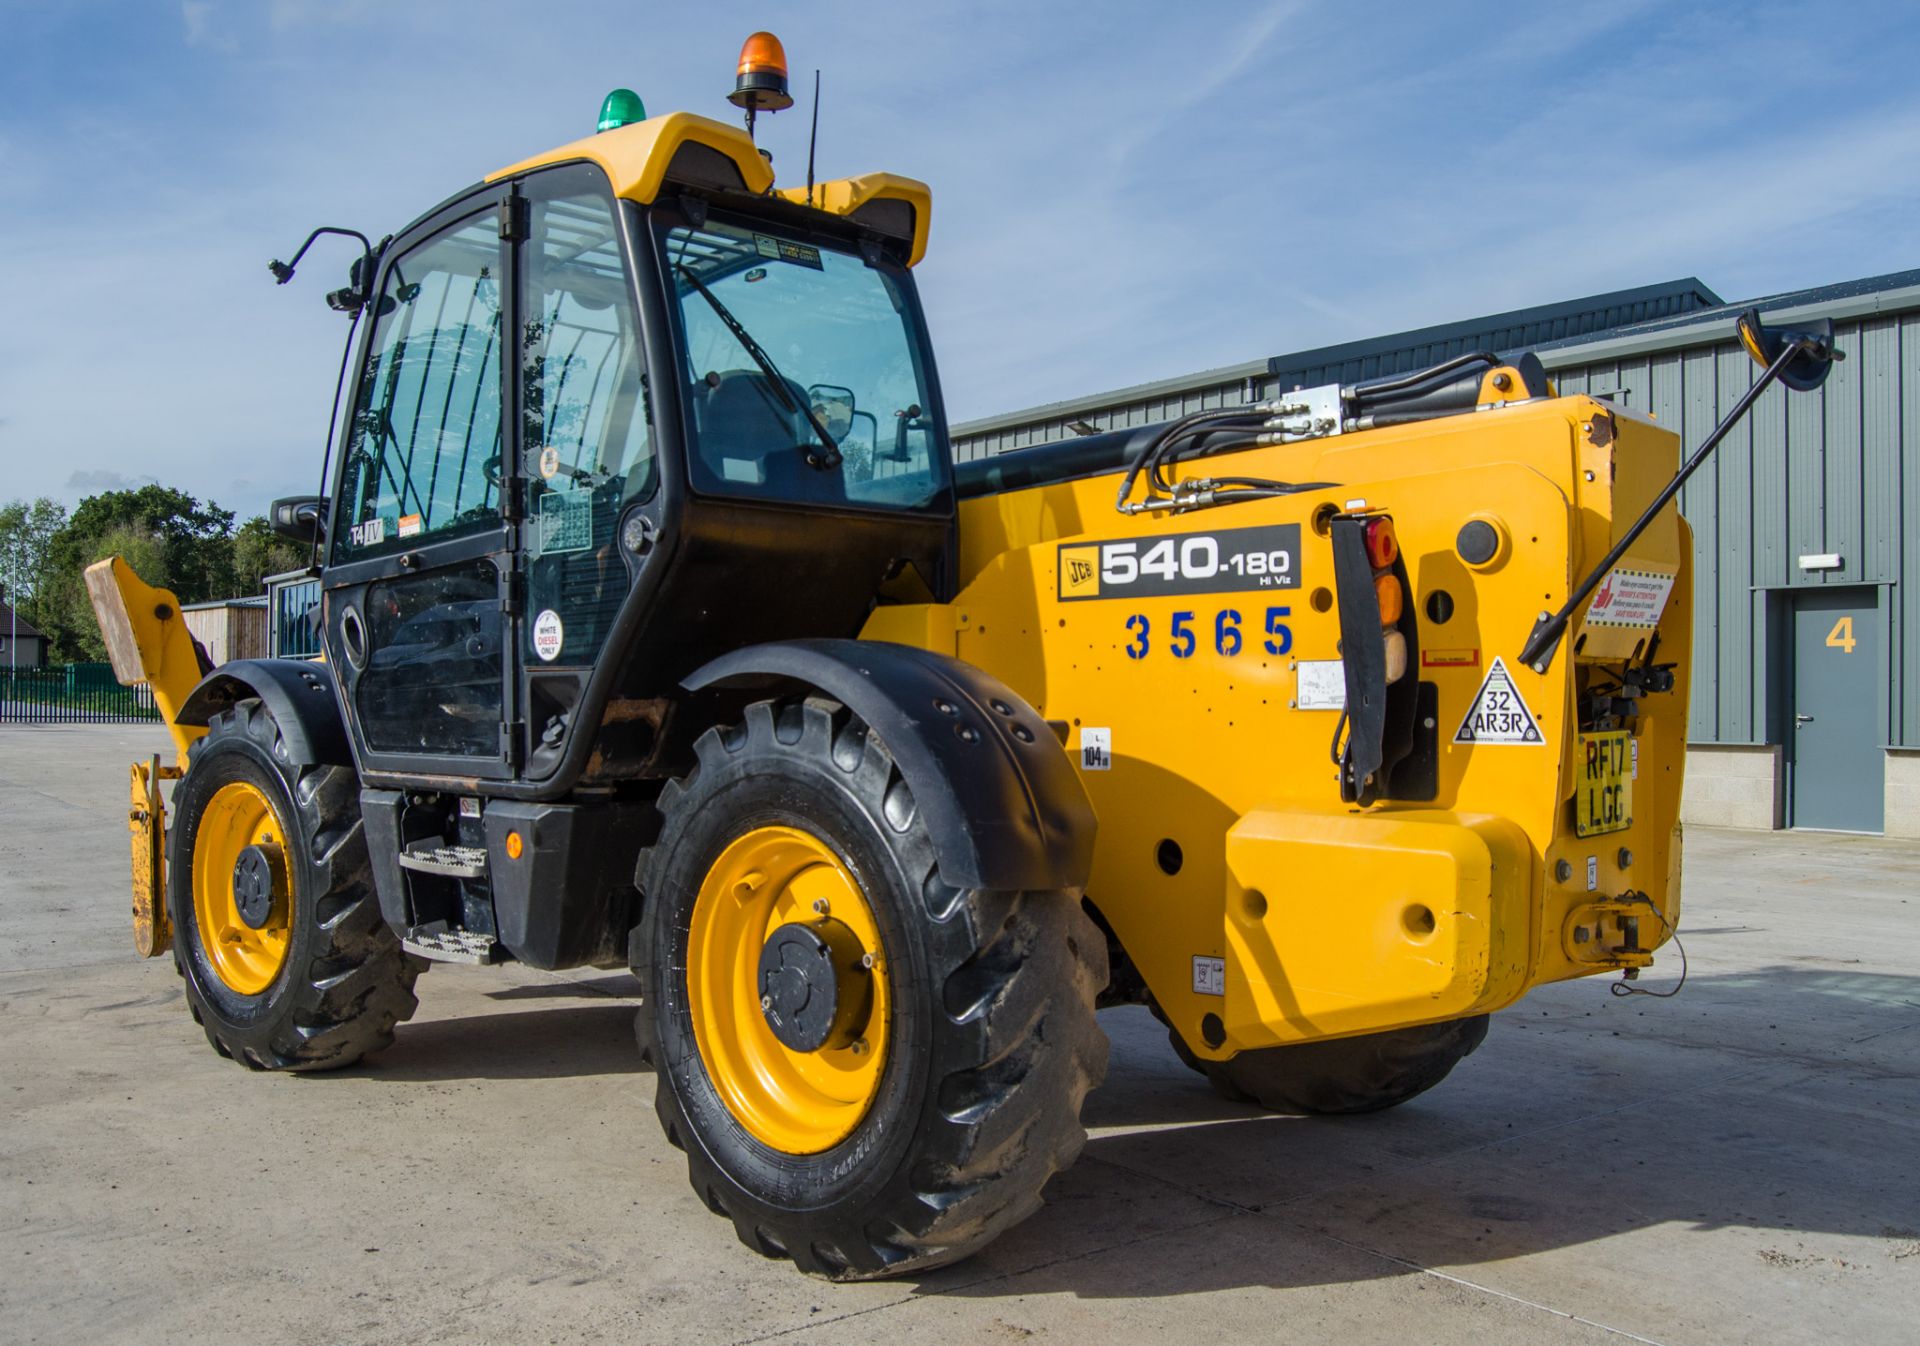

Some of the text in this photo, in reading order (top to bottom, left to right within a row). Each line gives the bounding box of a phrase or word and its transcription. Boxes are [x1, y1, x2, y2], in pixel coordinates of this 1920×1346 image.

[351, 525, 364, 546] T4
[1071, 560, 1092, 583] JCB
[1260, 575, 1292, 586] Hi Viz
[538, 636, 558, 645] DIESEL
[540, 626, 556, 635] WHITE
[1826, 616, 1857, 654] 4
[541, 647, 555, 656] ONLY
[1486, 691, 1510, 711] 32
[1474, 713, 1523, 733] AR3R
[1084, 746, 1101, 767] 104
[1586, 737, 1624, 780] RF17
